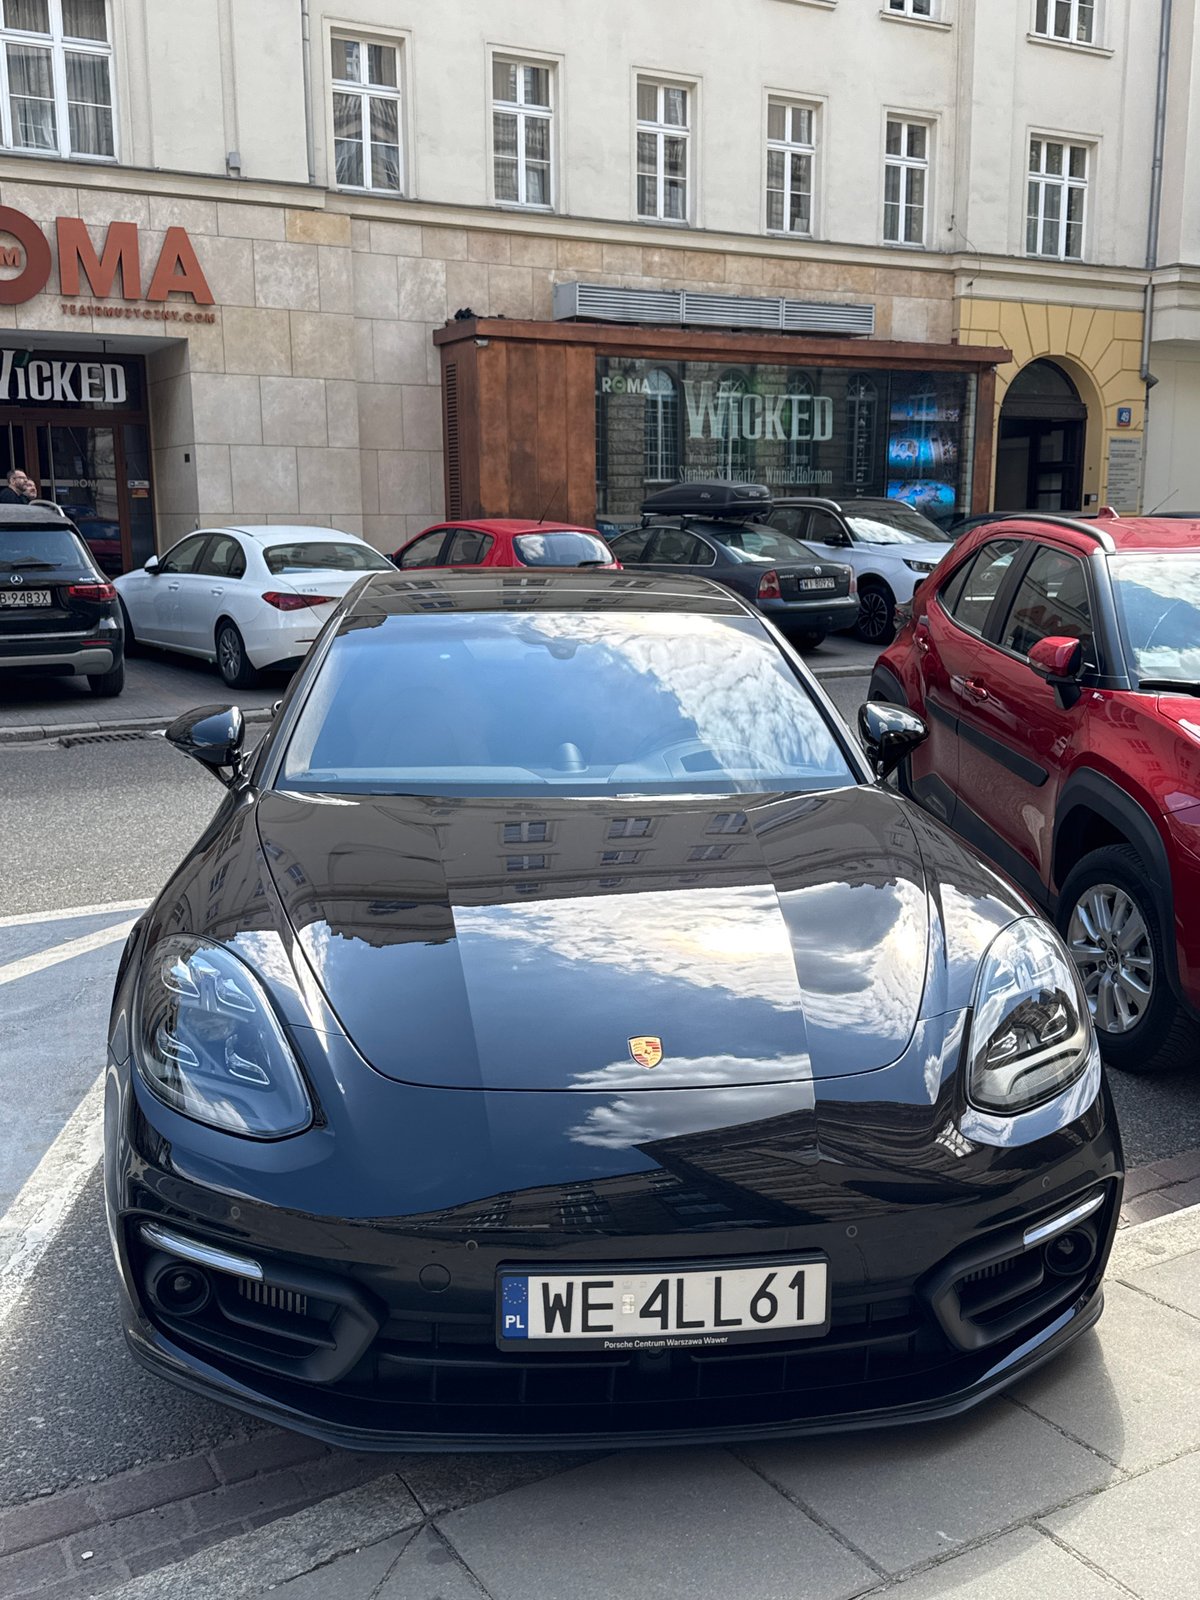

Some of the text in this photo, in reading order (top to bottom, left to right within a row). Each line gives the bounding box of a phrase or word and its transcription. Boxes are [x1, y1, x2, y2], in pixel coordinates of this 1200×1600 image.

[61, 303, 215, 324] TEATRMUZYCZNY.COM
[602, 376, 650, 394] ROMA
[765, 466, 833, 484] Winnie Holzman
[11, 592, 49, 605] 9483X
[541, 1270, 806, 1334] WE 4LL61
[505, 1315, 525, 1329] PL
[604, 1336, 729, 1349] Porsche Centrum Warszawa Wawer
